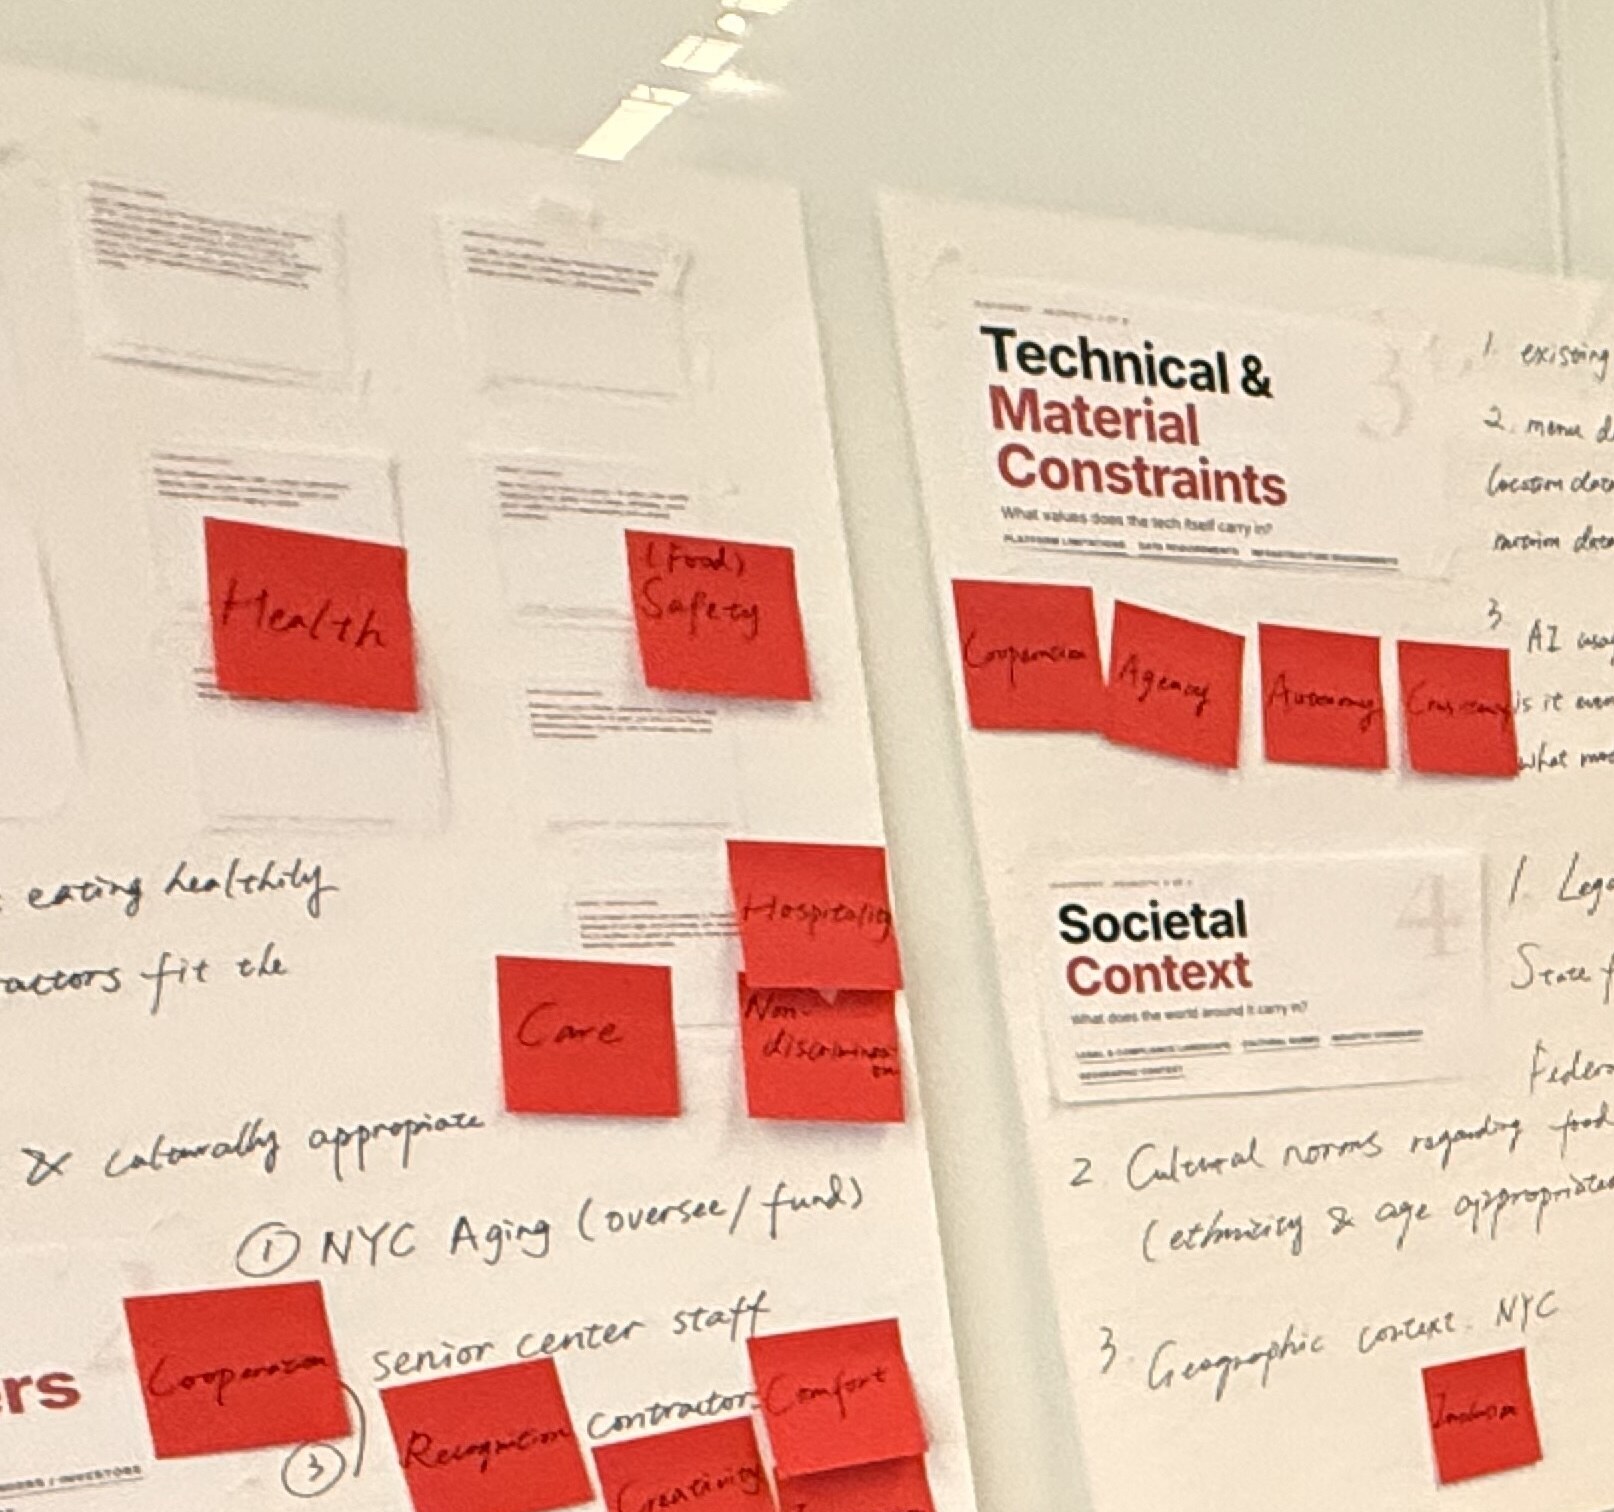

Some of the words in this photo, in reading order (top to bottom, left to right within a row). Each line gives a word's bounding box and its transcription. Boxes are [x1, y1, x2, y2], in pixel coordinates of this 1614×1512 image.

[980, 325, 1228, 394] Technical
[1241, 354, 1274, 398] &
[1521, 340, 1609, 383] existing
[989, 384, 1200, 446] Material
[999, 443, 1288, 507] Constraints
[1001, 506, 1038, 521] What
[1043, 511, 1087, 523] values
[1091, 512, 1123, 526] does
[1126, 514, 1149, 528] the
[1151, 517, 1180, 529] tech
[1184, 518, 1215, 531] itself
[1218, 522, 1250, 537] carry
[1254, 522, 1273, 535] in?
[222, 578, 386, 647] Health
[642, 577, 758, 641] Safety
[1528, 619, 1561, 652] AI
[1120, 654, 1209, 716] Agency
[1544, 691, 1562, 711] it
[1518, 743, 1568, 772] what
[28, 876, 141, 917] eating
[164, 858, 339, 918] healthily
[1059, 898, 1247, 944] Societal
[140, 951, 209, 1016] fit
[237, 941, 289, 976] the
[1066, 952, 1253, 997] Context
[1511, 942, 1591, 990] State
[517, 1002, 622, 1047] Care
[1072, 1012, 1105, 1025] What
[1108, 1012, 1138, 1023] does
[1141, 1009, 1161, 1021] the
[1165, 1008, 1198, 1020] world
[1203, 1005, 1243, 1017] around
[1257, 1003, 1288, 1016] carry
[1291, 1000, 1308, 1012] in?
[1127, 1136, 1265, 1191] Cultural
[1283, 1130, 1384, 1167] norms
[1410, 1114, 1521, 1170] regarding
[322, 1221, 416, 1266] NYC
[450, 1214, 550, 1265] Aging
[1329, 1206, 1355, 1234] &
[1375, 1202, 1430, 1250] age
[517, 1317, 645, 1359] center
[674, 1290, 771, 1336] staff
[1147, 1323, 1323, 1401] Geographic
[1496, 1290, 1559, 1331] NYC
[0, 1371, 81, 1414] rs
[766, 1367, 886, 1419] Comfort
[403, 1424, 571, 1473] Recognition
